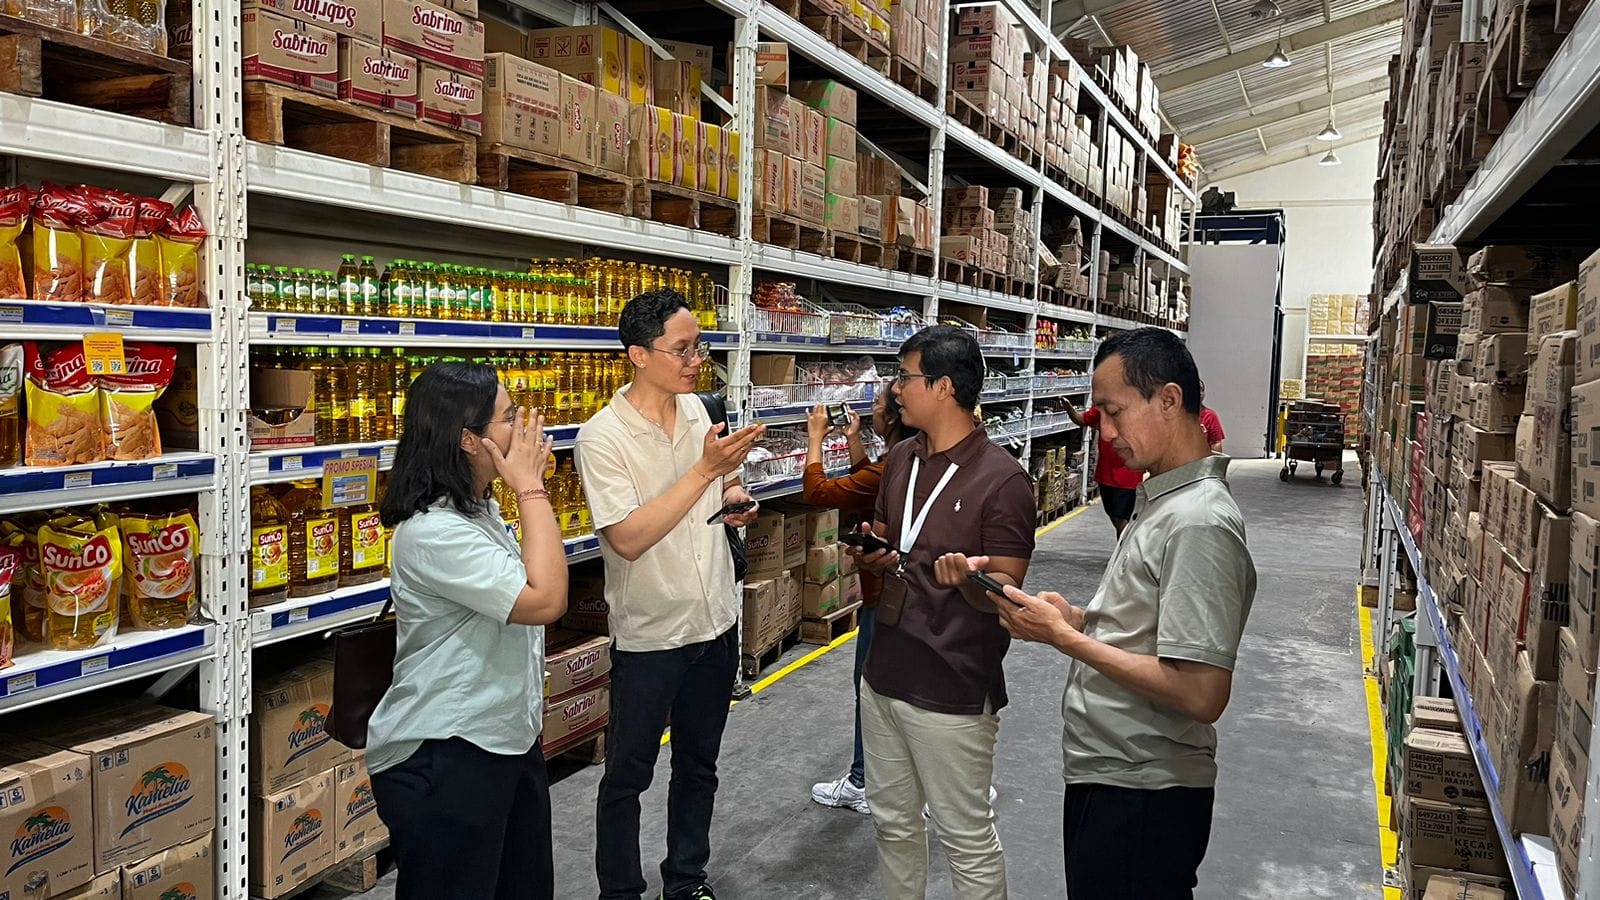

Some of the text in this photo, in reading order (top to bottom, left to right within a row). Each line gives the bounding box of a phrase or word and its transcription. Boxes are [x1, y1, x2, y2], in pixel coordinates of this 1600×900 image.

[293, 0, 356, 28] Sabrina
[412, 5, 462, 34] Sabrina
[273, 30, 328, 56] Sabrina
[363, 56, 409, 80] Sabrina
[434, 79, 475, 100] Sabrina
[325, 459, 376, 474] PROMO SPESIAL
[313, 523, 334, 535] SunCo
[359, 516, 379, 528] SunCo
[128, 530, 186, 553] SunCo
[260, 531, 282, 545] SunCo
[747, 537, 769, 550] SunCo
[44, 544, 109, 569] SunCo
[579, 600, 607, 612] SunCo
[565, 650, 600, 676] Sabrina
[562, 693, 596, 722] Sabrina
[288, 723, 323, 750] Kame
[1444, 777, 1474, 787] MANIS
[1445, 770, 1475, 779] KECAP
[125, 775, 192, 817] Kamelia
[10, 819, 72, 858] Kamelia
[284, 818, 323, 848] Kamelia
[1454, 838, 1494, 850] KECAP
[1454, 848, 1495, 860] MANIS
